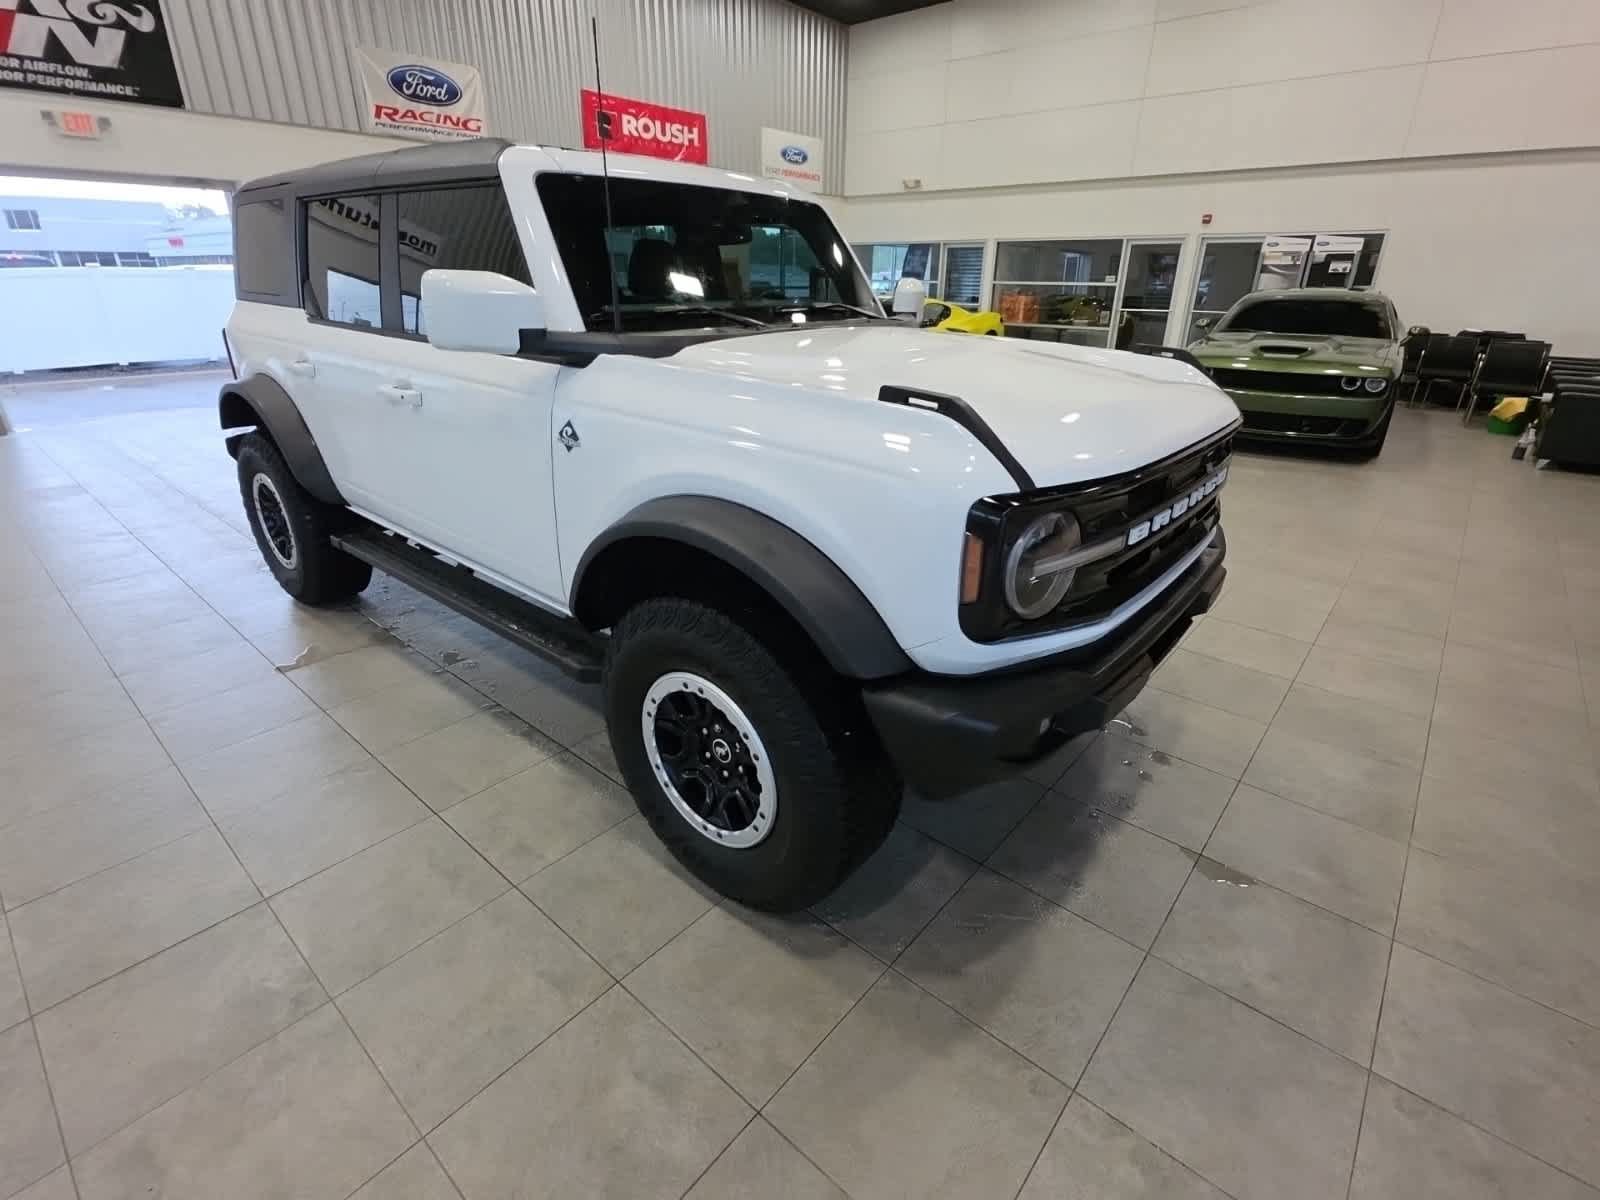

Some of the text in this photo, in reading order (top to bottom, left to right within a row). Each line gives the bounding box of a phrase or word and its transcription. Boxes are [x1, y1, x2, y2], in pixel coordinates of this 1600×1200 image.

[23, 59, 92, 79] AIRFLOW.
[403, 70, 449, 101] Ford
[374, 104, 481, 132] RACING
[621, 112, 701, 147] ROUSH
[1127, 467, 1227, 545] BRONCO
